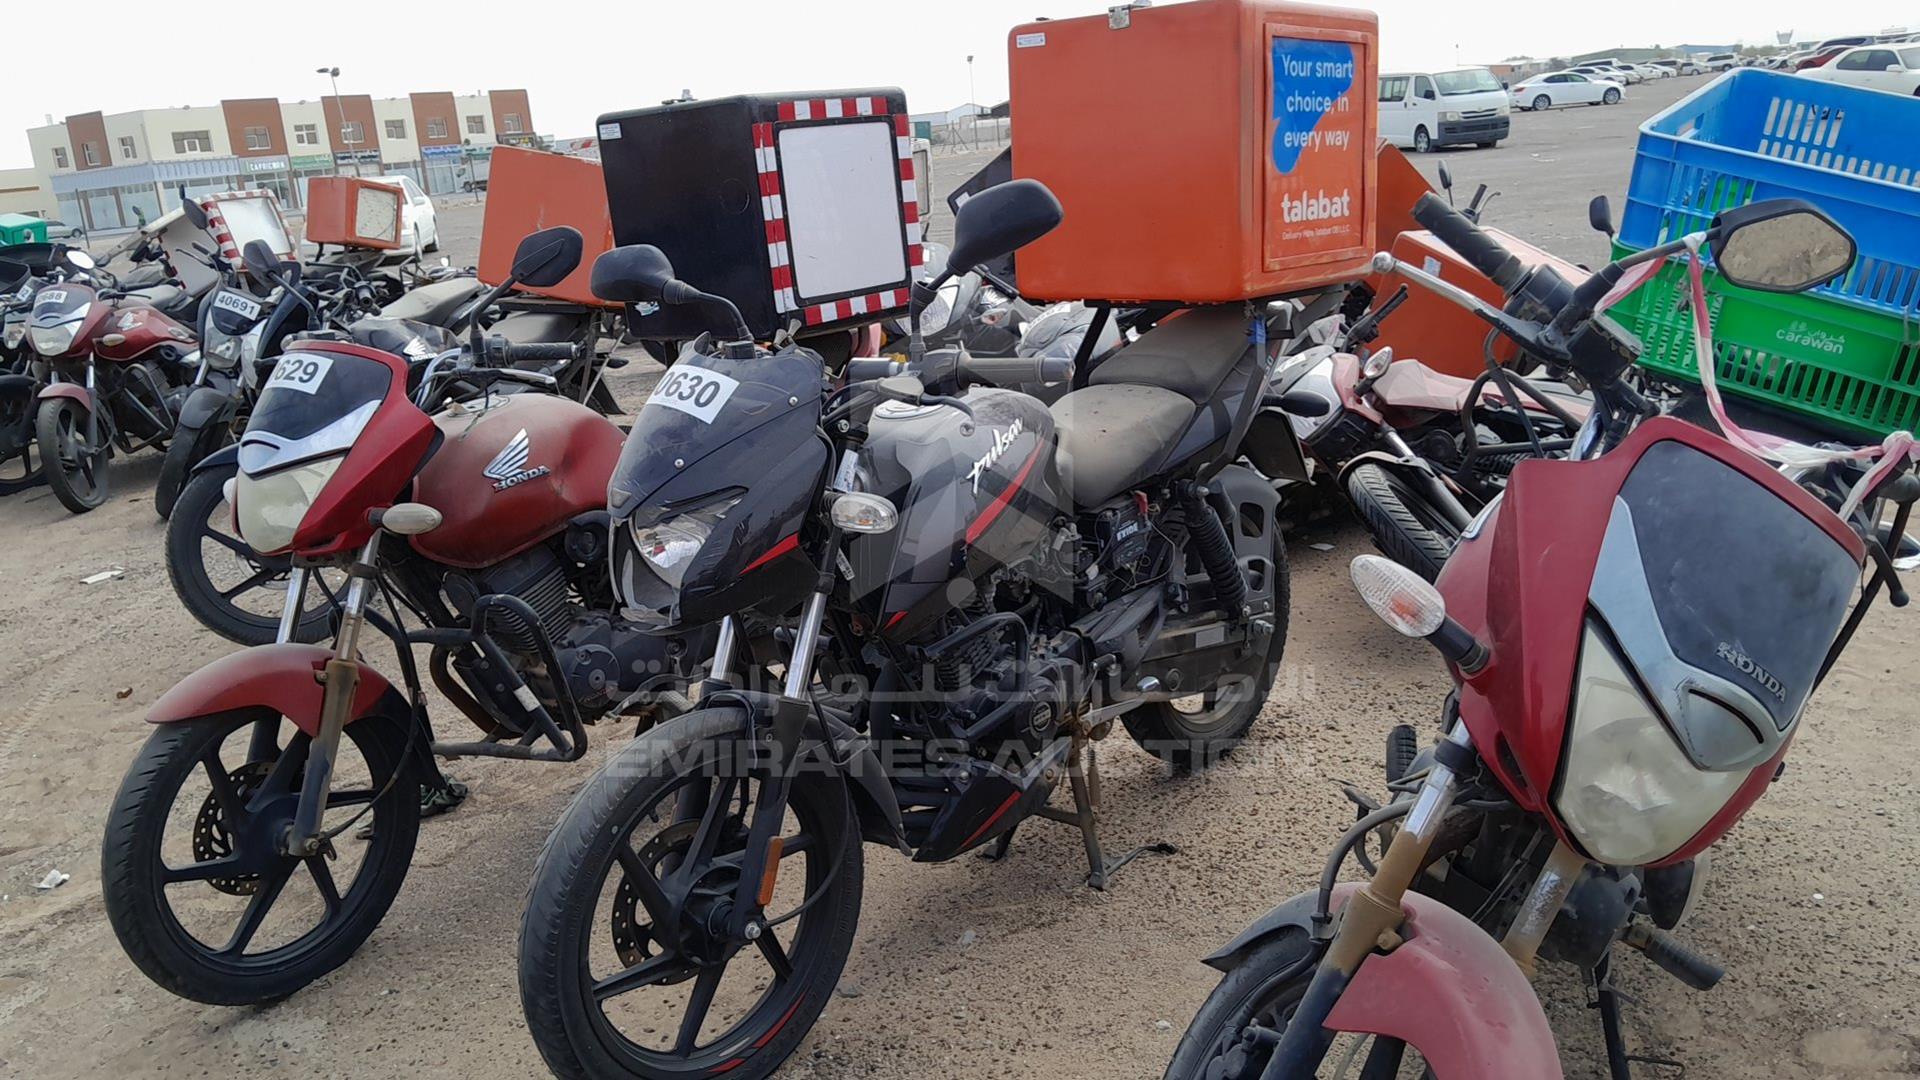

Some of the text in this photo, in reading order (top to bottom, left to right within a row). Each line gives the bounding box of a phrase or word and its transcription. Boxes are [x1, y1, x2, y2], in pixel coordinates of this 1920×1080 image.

[1282, 54, 1353, 78] Your smart
[1286, 91, 1349, 115] choice, in
[1284, 130, 1350, 152] every way
[1281, 188, 1351, 223] talabat
[218, 294, 256, 316] 40691
[1775, 328, 1844, 354] carawan
[492, 465, 552, 492] HONDA
[1715, 641, 1787, 704] HONDA
